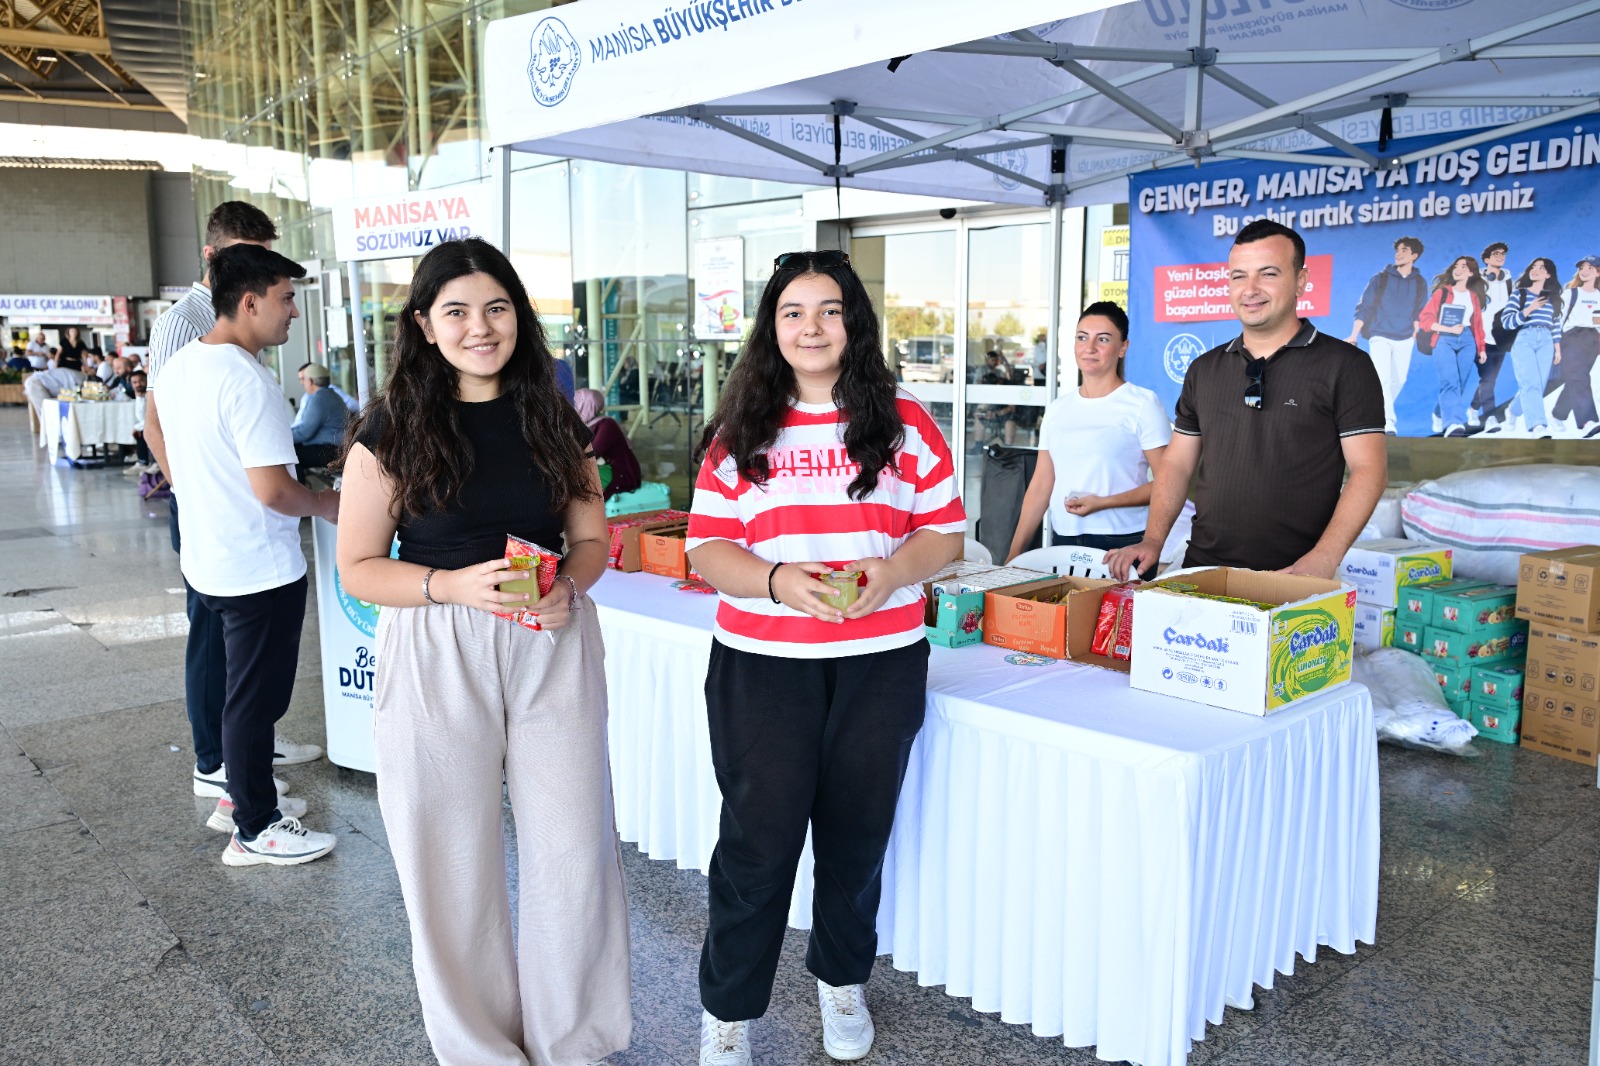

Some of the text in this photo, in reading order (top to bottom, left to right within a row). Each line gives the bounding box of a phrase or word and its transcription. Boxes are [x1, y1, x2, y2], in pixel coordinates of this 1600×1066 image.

[589, 22, 656, 63] MANİSA
[1138, 177, 1250, 215] GENÇLER,
[1415, 149, 1480, 186] HOŞ
[354, 197, 471, 229] MANİSA'YA
[1213, 214, 1239, 236] Bu
[1300, 200, 1354, 229] artık
[1358, 194, 1414, 224] sizin
[1419, 191, 1450, 218] de
[1456, 181, 1534, 214] eviniz
[357, 227, 434, 252] SÖZÜMÜZ
[1167, 266, 1230, 282] Yeni başla
[14, 299, 38, 310] CAFE
[40, 298, 58, 312] ÇAY
[60, 299, 99, 311] SALONU
[1164, 284, 1197, 302] güzel
[1198, 284, 1230, 298] dost
[1166, 302, 1234, 318] başarıların
[1163, 627, 1229, 653] Çardak
[1289, 620, 1338, 658] Çardak
[355, 646, 375, 669] Be
[339, 666, 375, 691] DUT
